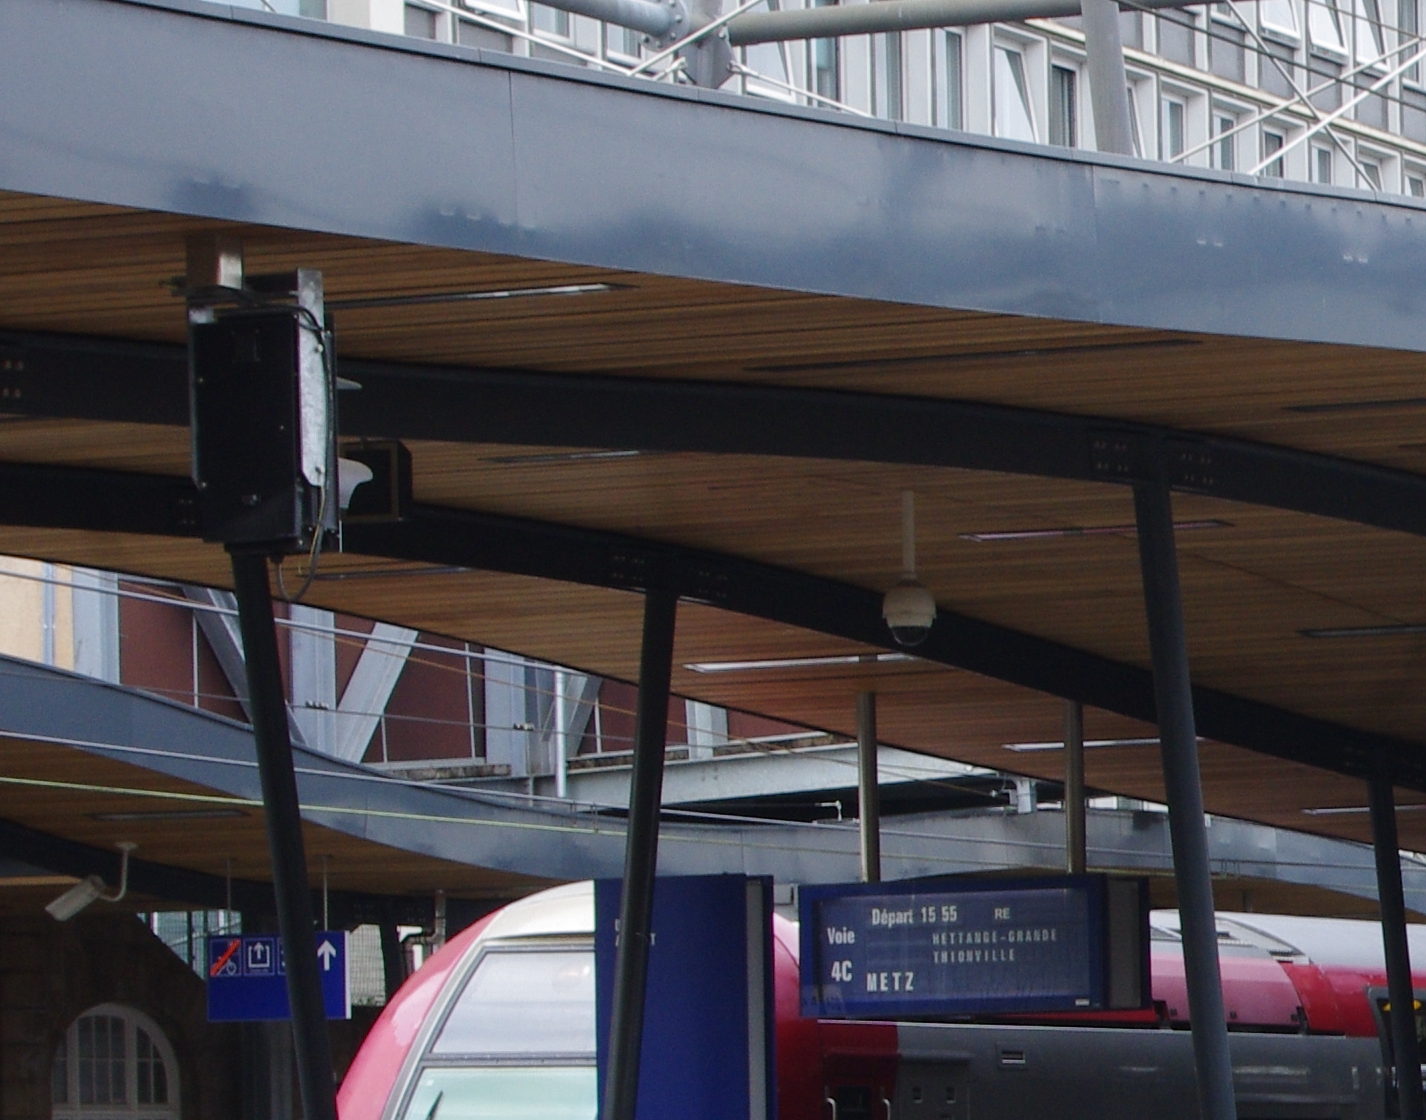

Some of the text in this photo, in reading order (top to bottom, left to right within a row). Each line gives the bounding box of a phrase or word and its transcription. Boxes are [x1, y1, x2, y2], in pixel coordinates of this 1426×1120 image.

[871, 904, 1011, 928] Départ 15 55 RE
[826, 926, 856, 946] Voie
[933, 948, 1015, 964] THIONVILLE
[830, 960, 853, 983] 4C
[866, 971, 914, 993] METZ
